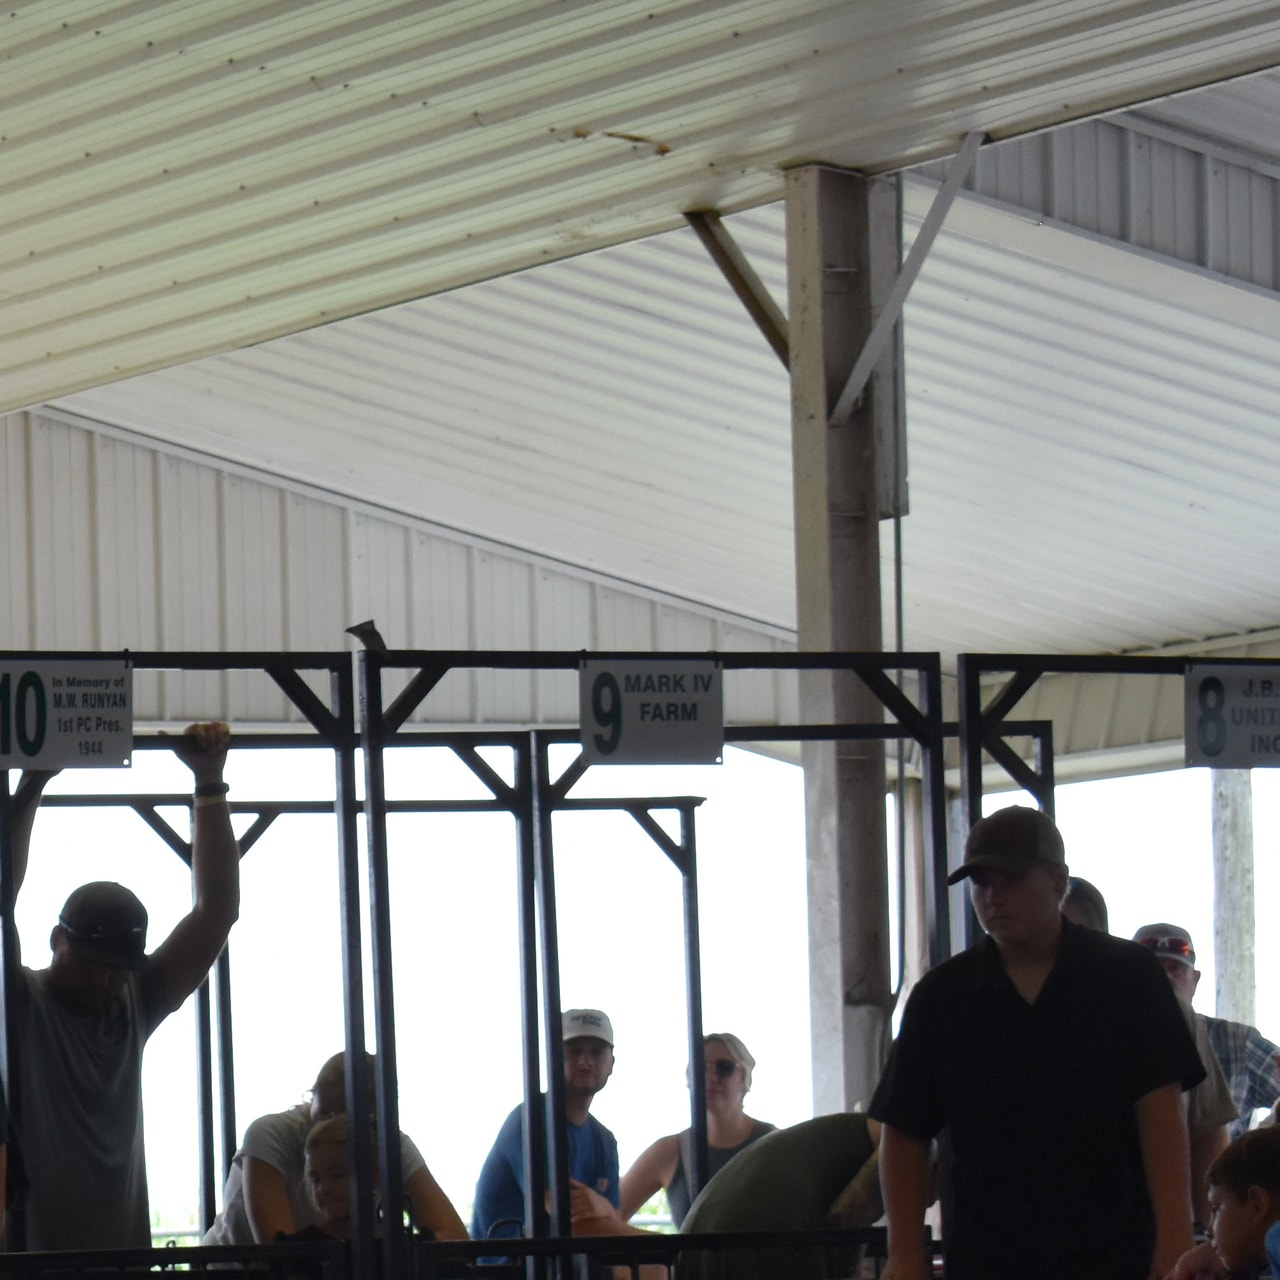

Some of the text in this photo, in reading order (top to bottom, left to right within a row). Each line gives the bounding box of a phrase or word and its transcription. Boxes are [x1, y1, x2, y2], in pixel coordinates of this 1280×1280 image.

[52, 677, 125, 690] In Memory of
[624, 674, 713, 693] MARK IV
[53, 693, 127, 709] M.W. RUNYAN
[591, 671, 622, 756] 9
[640, 702, 698, 721] FARM
[1197, 676, 1227, 758] 8
[57, 717, 124, 733] 1st PC Pres.
[78, 741, 104, 756] 1944
